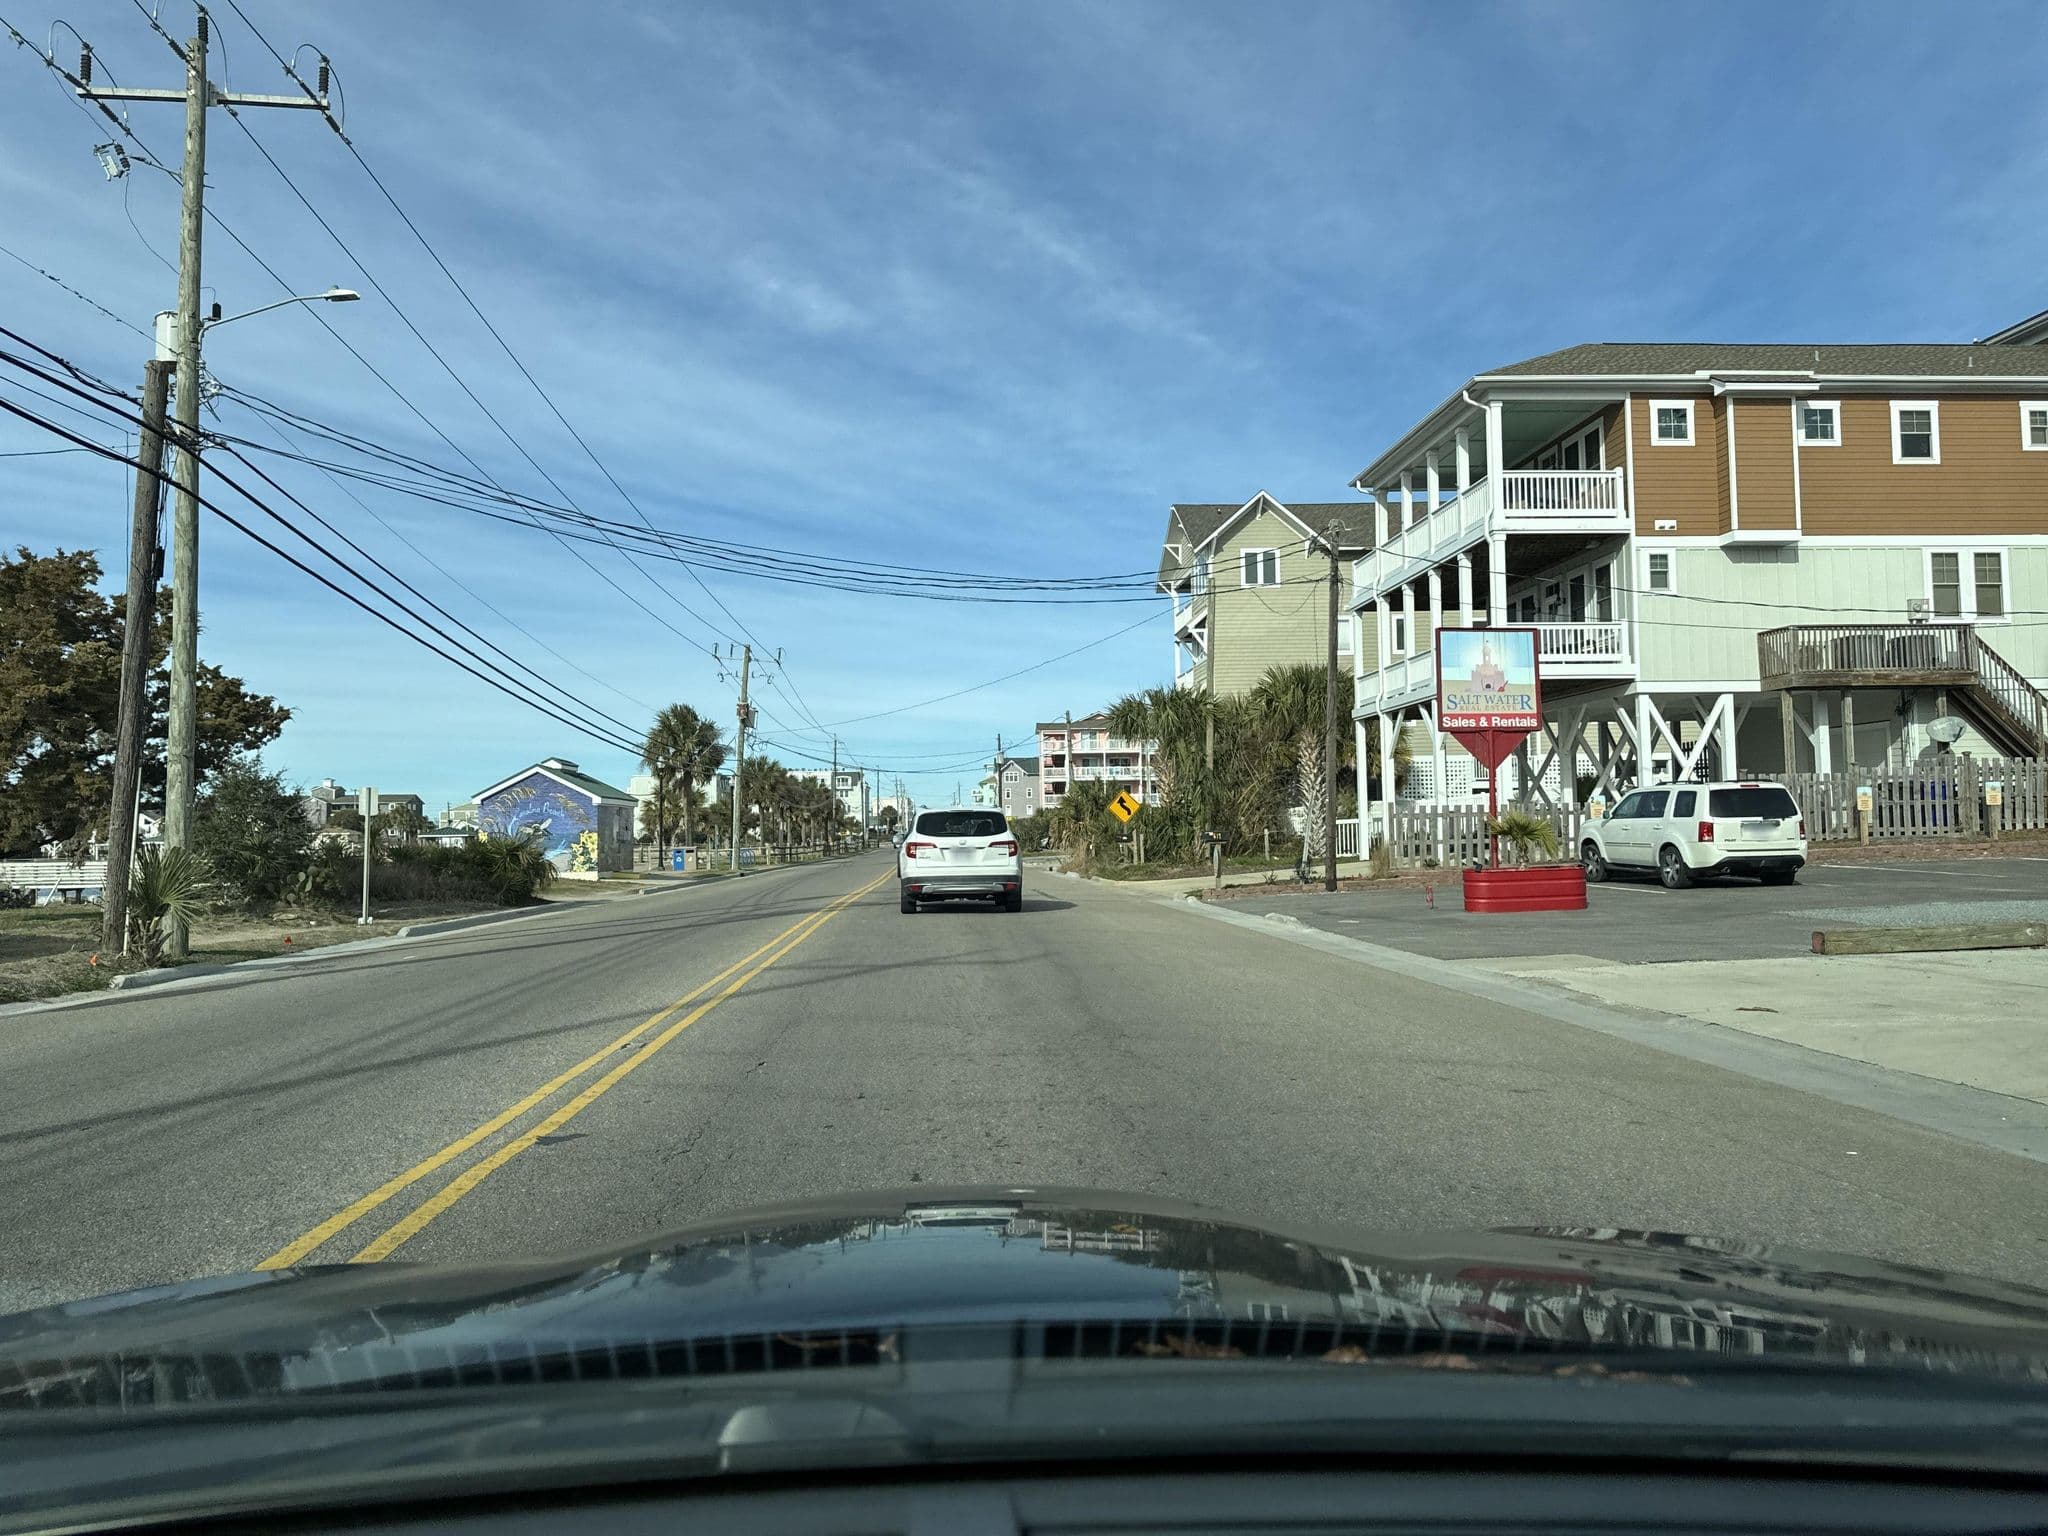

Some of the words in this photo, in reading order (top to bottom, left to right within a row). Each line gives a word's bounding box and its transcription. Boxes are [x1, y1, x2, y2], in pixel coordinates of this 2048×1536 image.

[1447, 694, 1481, 710] SALT
[1484, 694, 1533, 710] WATER
[1443, 717, 1476, 727] Sales
[1480, 717, 1488, 727] &
[1492, 717, 1537, 727] Rentals
